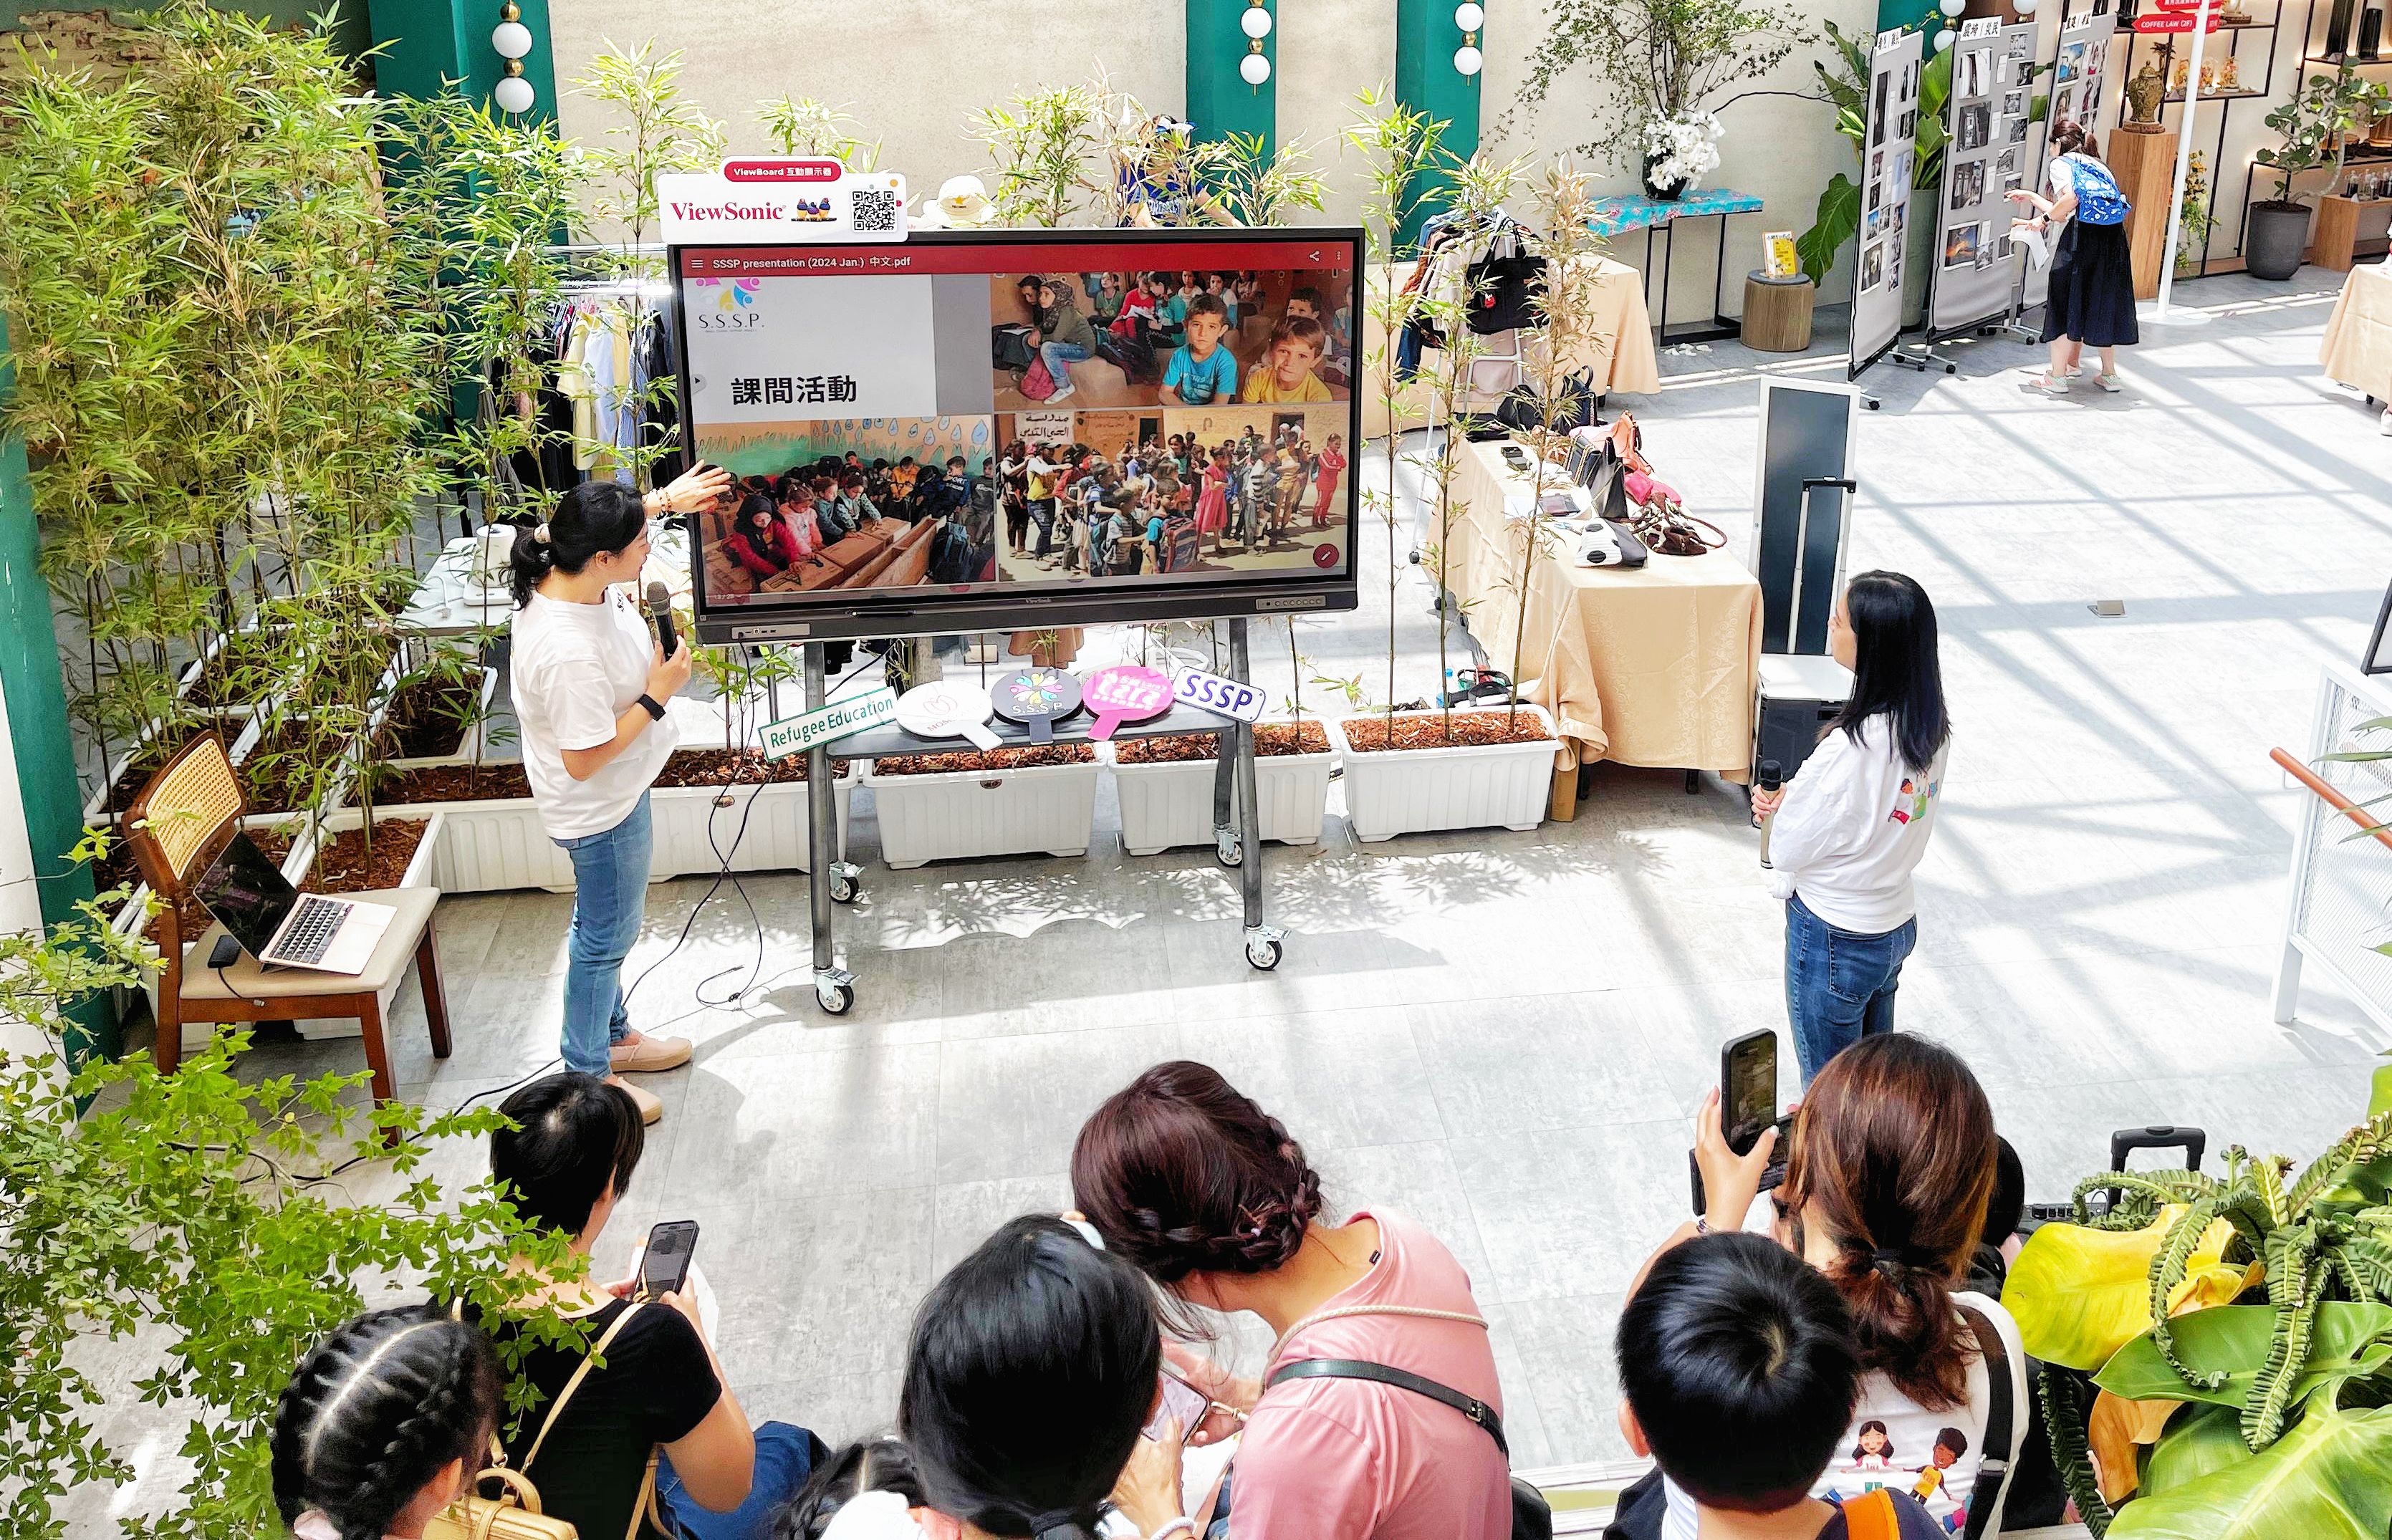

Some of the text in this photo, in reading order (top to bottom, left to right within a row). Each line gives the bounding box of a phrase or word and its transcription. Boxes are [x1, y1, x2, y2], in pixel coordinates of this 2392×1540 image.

[671, 202, 784, 221] ViewSonic
[713, 259, 741, 269] SSSP
[743, 258, 805, 270] presentation
[807, 256, 837, 269] (2024
[699, 313, 764, 329] S.S.S.P.
[731, 375, 857, 405] 課間活動
[1181, 674, 1253, 713] SSSP
[770, 698, 893, 749] Refugee Education
